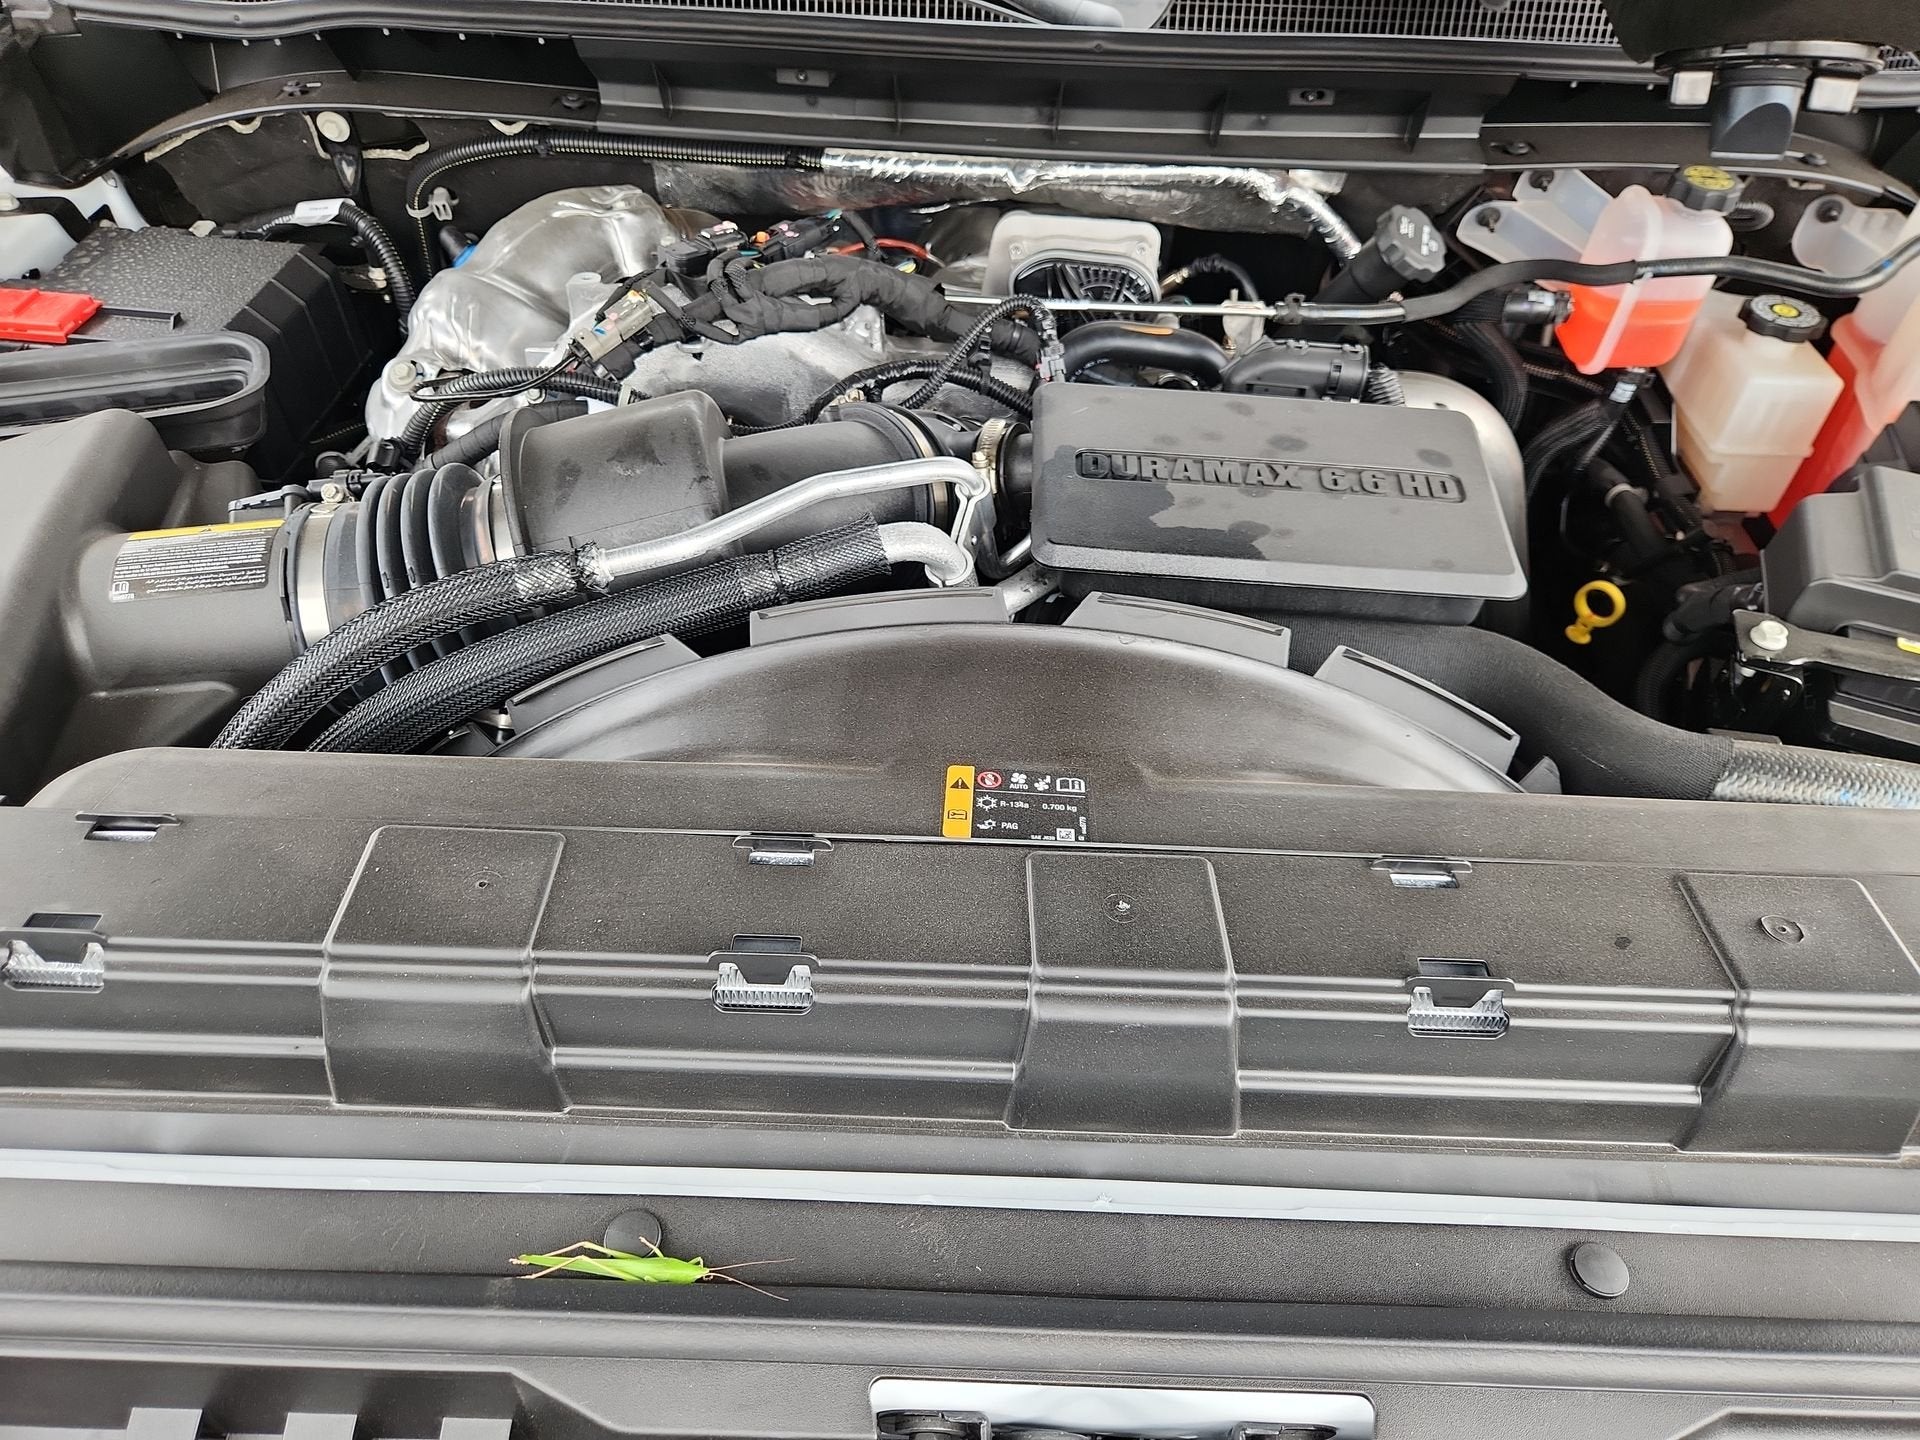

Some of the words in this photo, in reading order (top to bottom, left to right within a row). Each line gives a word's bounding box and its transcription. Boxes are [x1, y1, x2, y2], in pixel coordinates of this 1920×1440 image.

[1081, 451, 1303, 489] DURAMAX
[1318, 465, 1389, 495] 6.6
[1398, 471, 1463, 500] HD
[999, 800, 1030, 809] R-134a
[1041, 803, 1065, 811] 0.700
[1066, 804, 1078, 813] kg
[1001, 822, 1019, 830] PAG
